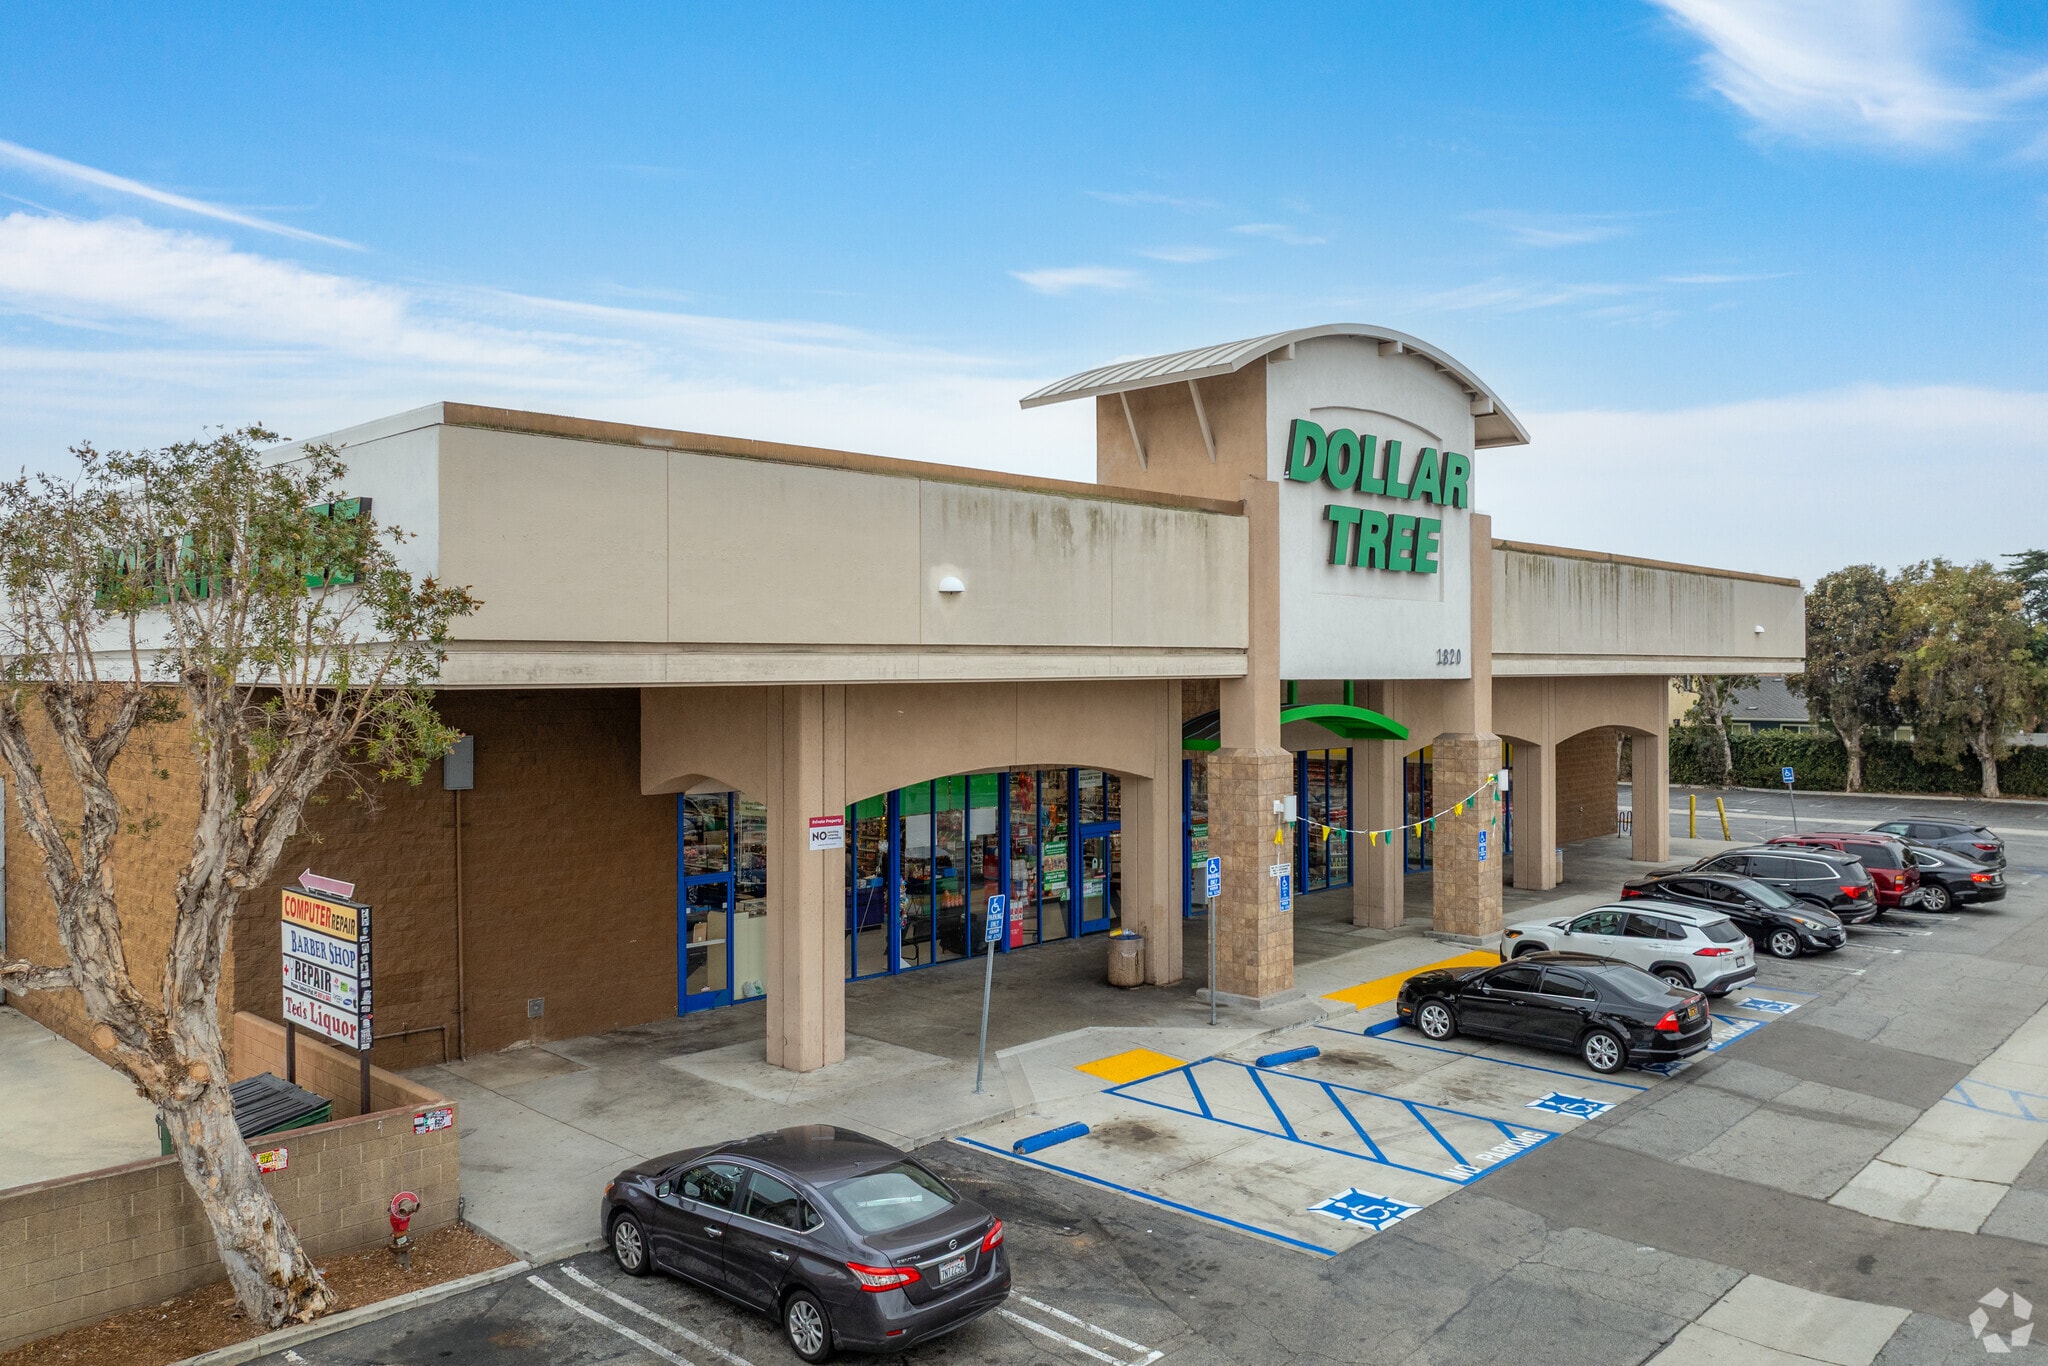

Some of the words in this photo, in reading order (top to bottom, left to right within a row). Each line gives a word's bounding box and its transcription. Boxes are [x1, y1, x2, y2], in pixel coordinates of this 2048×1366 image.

[1284, 418, 1471, 510] DOLLAR
[1323, 504, 1441, 574] TREE
[1436, 649, 1462, 665] 1820
[812, 831, 827, 841] NO
[285, 895, 331, 928] COMPUTER
[331, 914, 355, 935] REPAIR
[291, 930, 327, 960] BARBER
[328, 942, 356, 968] SHOP
[295, 960, 331, 993] REPAIR
[285, 996, 307, 1020] Ted's
[309, 1001, 357, 1040] Liquor
[1443, 1163, 1483, 1181] NO
[1475, 1131, 1548, 1164] PARKING
